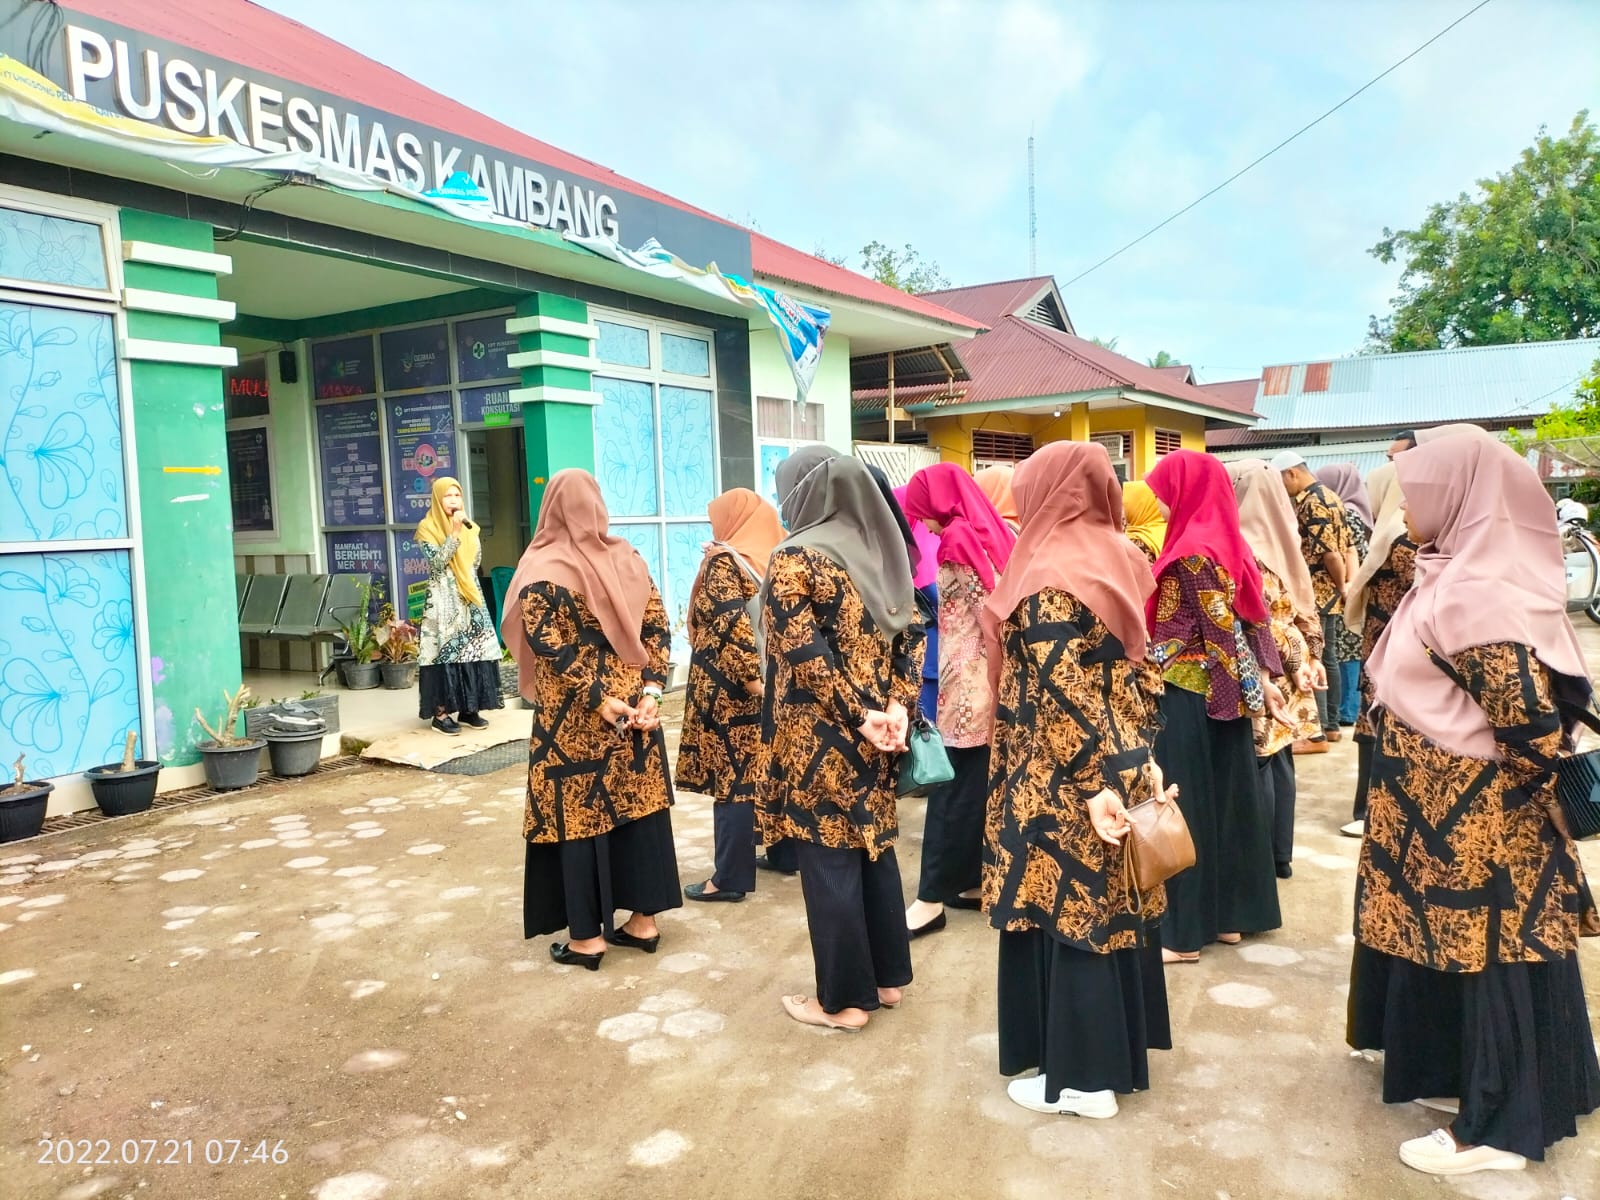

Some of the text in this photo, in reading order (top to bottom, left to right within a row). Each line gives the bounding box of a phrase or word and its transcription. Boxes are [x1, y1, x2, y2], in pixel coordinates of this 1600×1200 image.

[64, 24, 619, 243] PUSKESMAS KAMBANG
[485, 391, 509, 405] RUAN
[481, 402, 520, 416] KONSULTASI
[335, 550, 382, 560] BERHENTI
